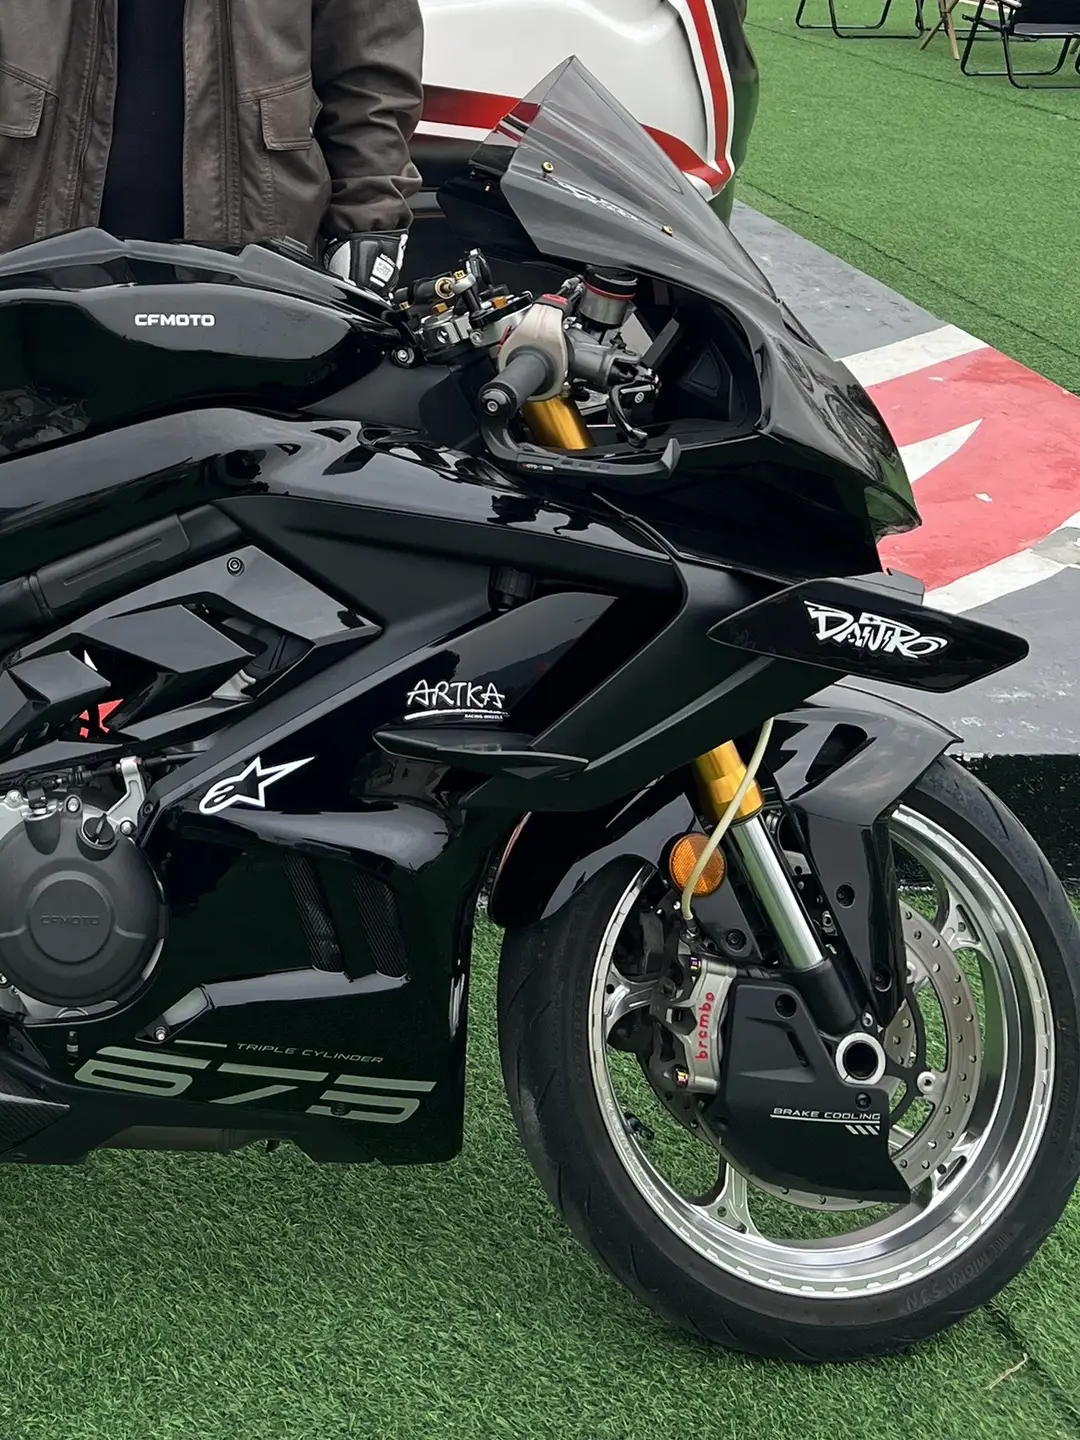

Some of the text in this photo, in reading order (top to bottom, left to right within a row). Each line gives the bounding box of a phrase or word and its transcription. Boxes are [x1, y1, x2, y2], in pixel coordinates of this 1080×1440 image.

[134, 313, 216, 327] CFMOTO
[407, 679, 506, 709] ARTKA
[695, 991, 715, 1061] brembo
[236, 1042, 384, 1064] TRIPLE CYLINDER
[74, 1046, 437, 1124] 675
[773, 1107, 880, 1120] BRAKE COOLING
